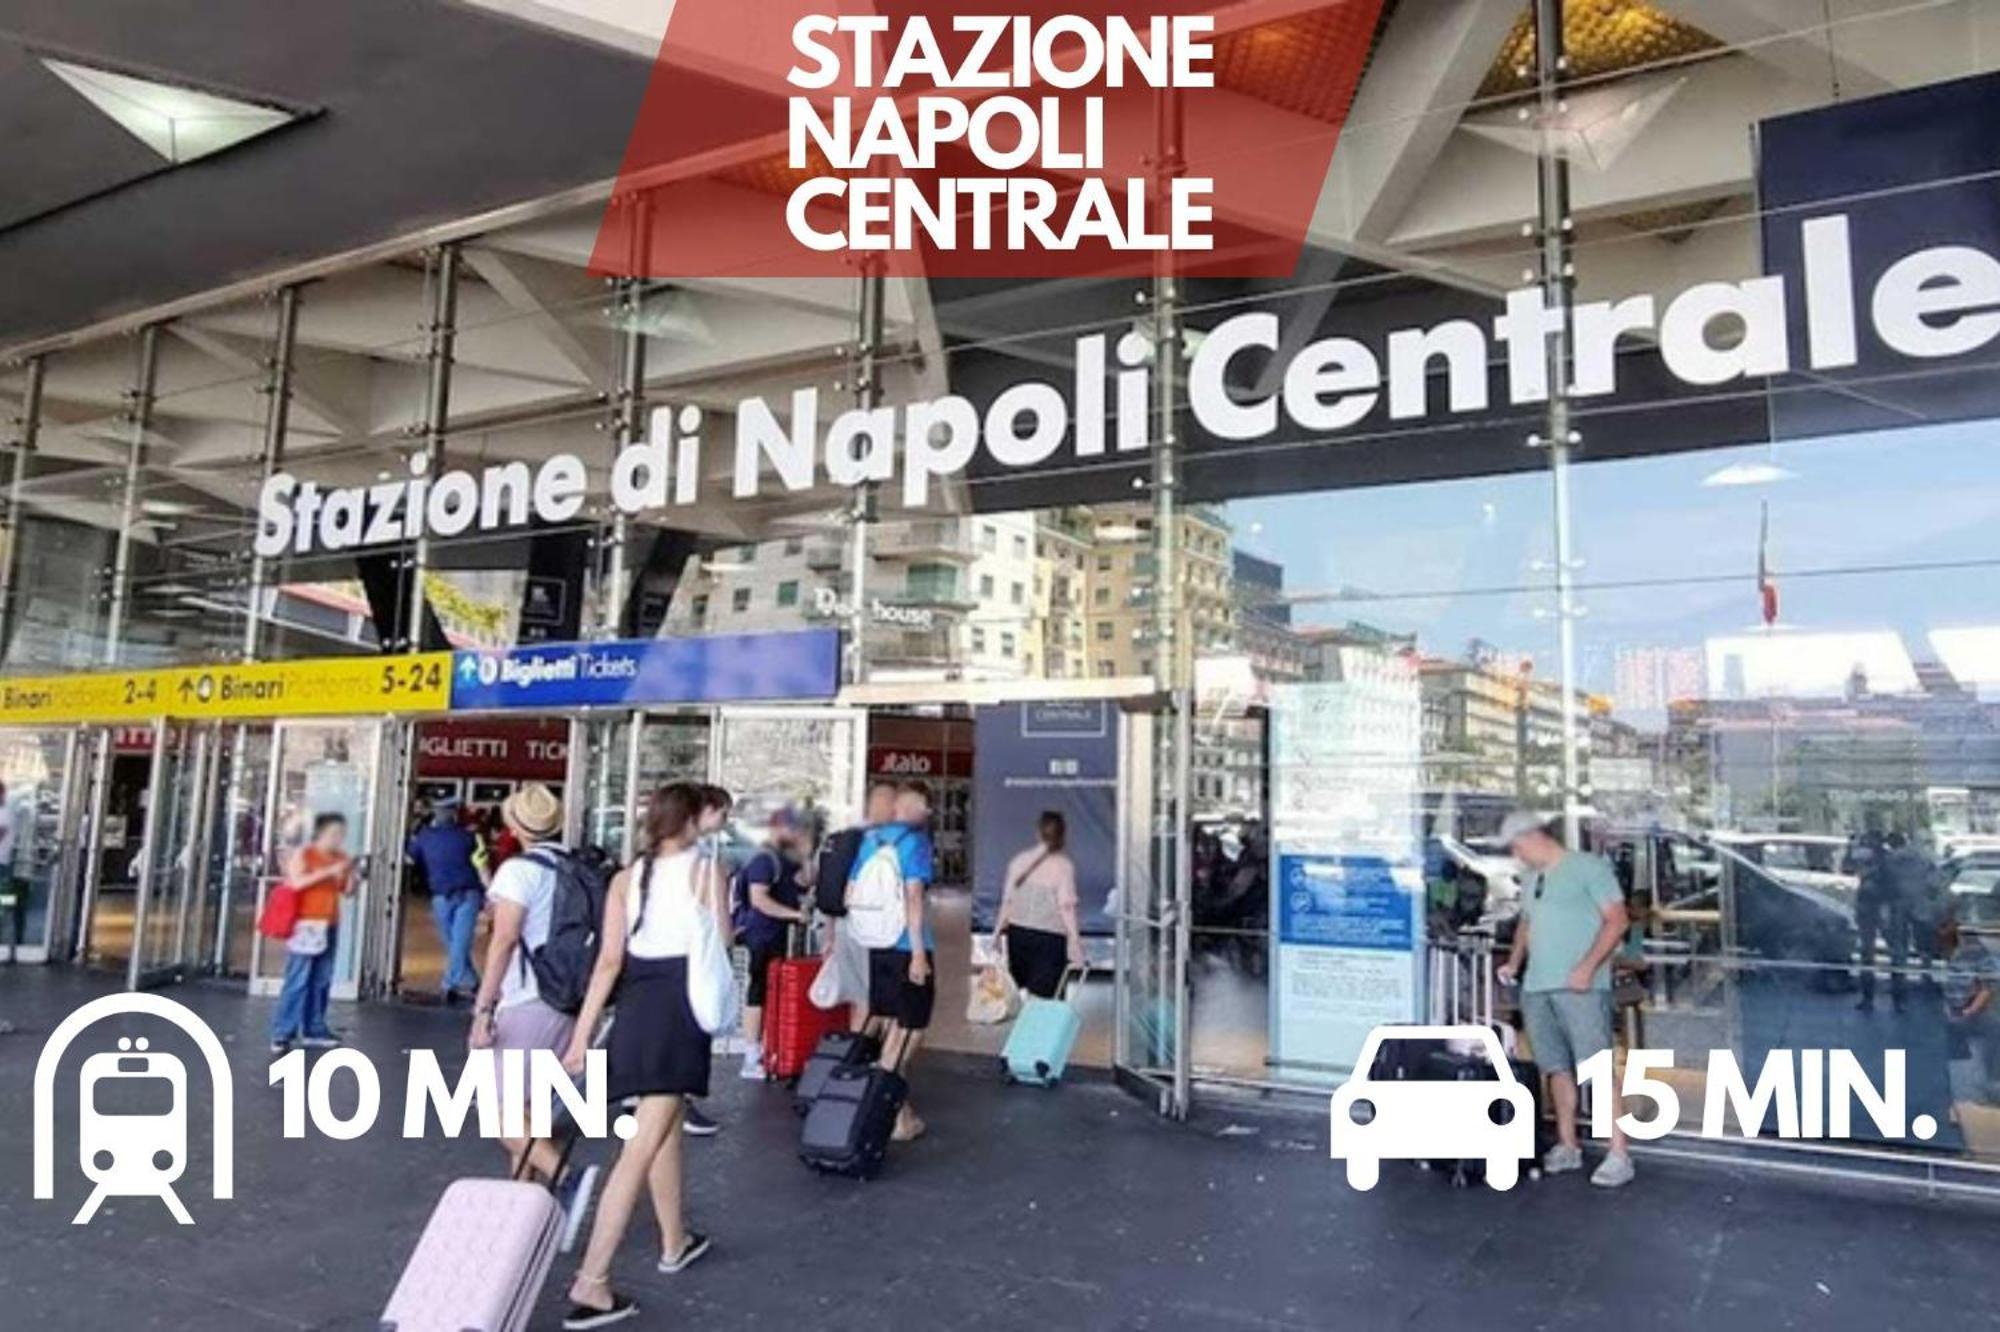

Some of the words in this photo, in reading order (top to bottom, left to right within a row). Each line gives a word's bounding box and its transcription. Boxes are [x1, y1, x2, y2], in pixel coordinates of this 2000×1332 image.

[255, 453, 586, 557] Stazione
[611, 405, 701, 513] di
[733, 331, 1150, 508] Napoli
[1188, 213, 2000, 440] Centrale
[221, 672, 284, 700] Binari
[382, 661, 441, 694] 5-24
